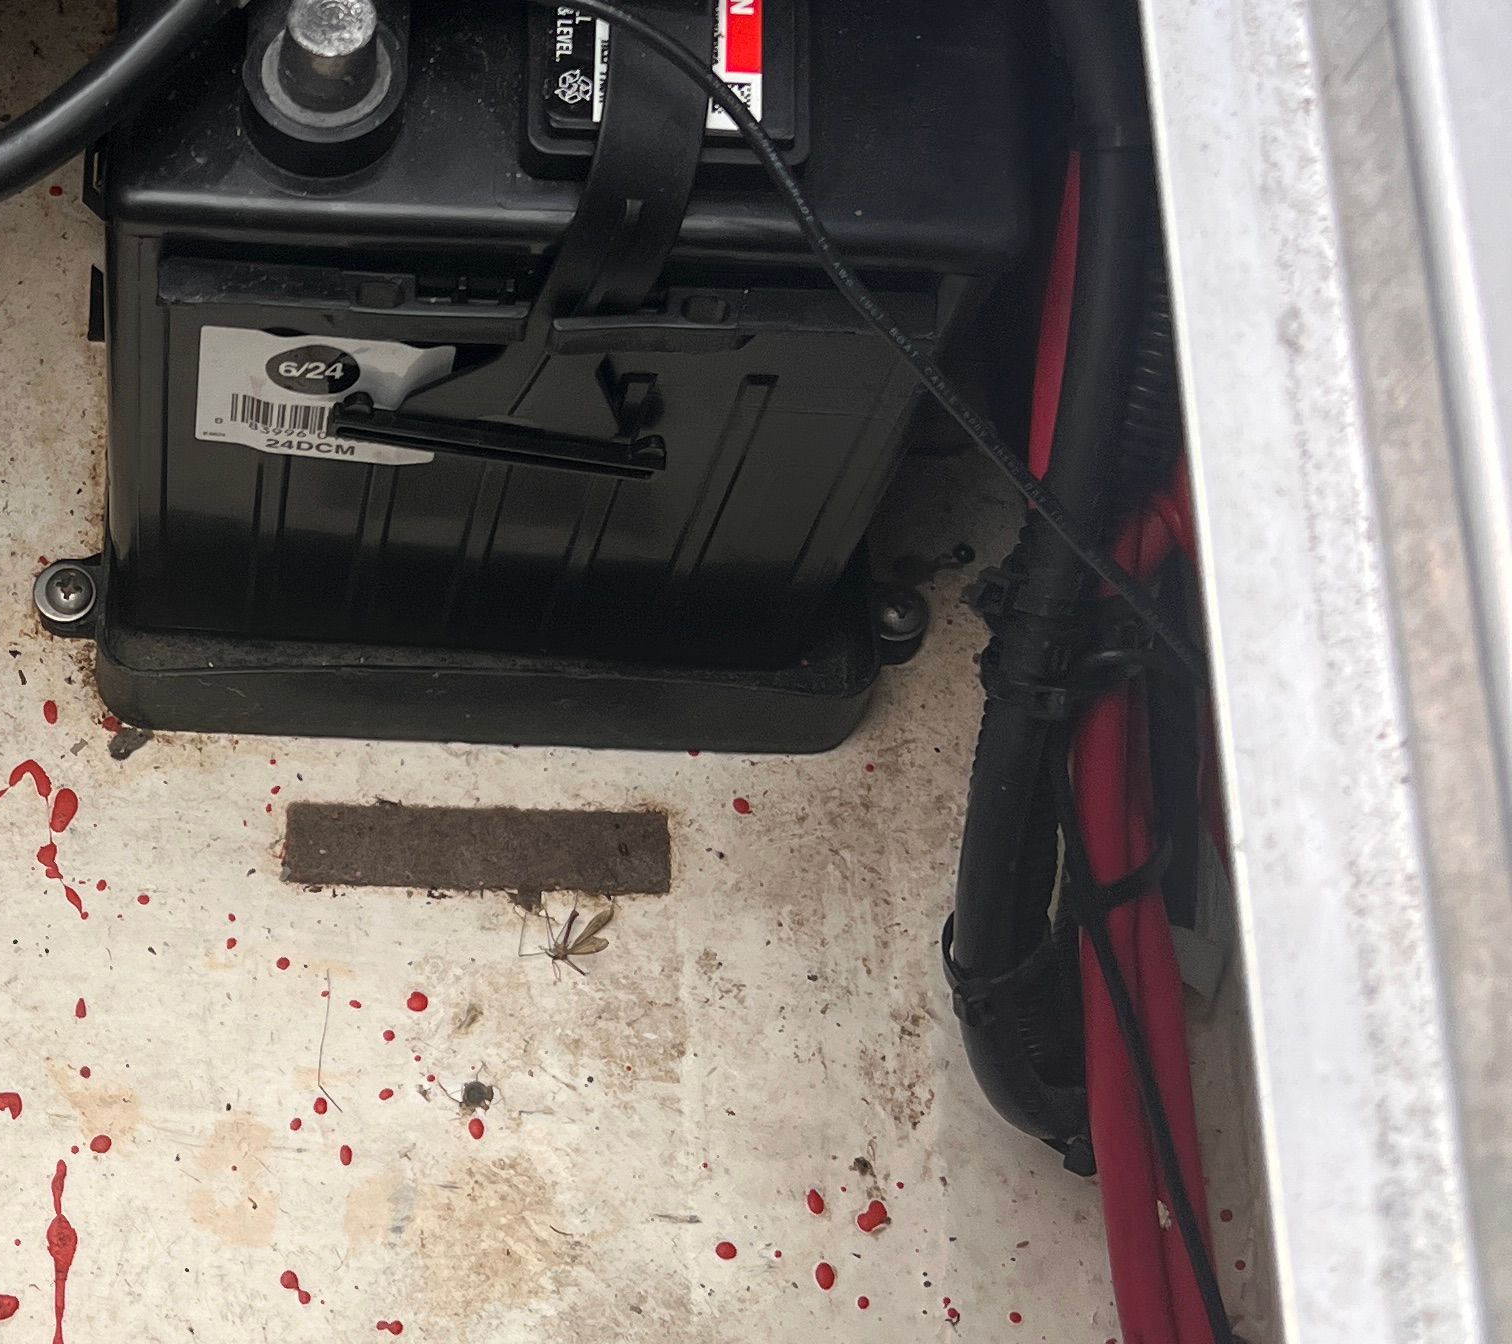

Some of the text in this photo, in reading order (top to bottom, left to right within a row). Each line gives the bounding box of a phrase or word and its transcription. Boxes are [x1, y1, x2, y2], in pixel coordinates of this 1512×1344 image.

[555, 18, 574, 63] LEVEL.
[277, 360, 346, 381] 6/24
[214, 416, 224, 425] 0
[265, 437, 356, 457] 24DCM
